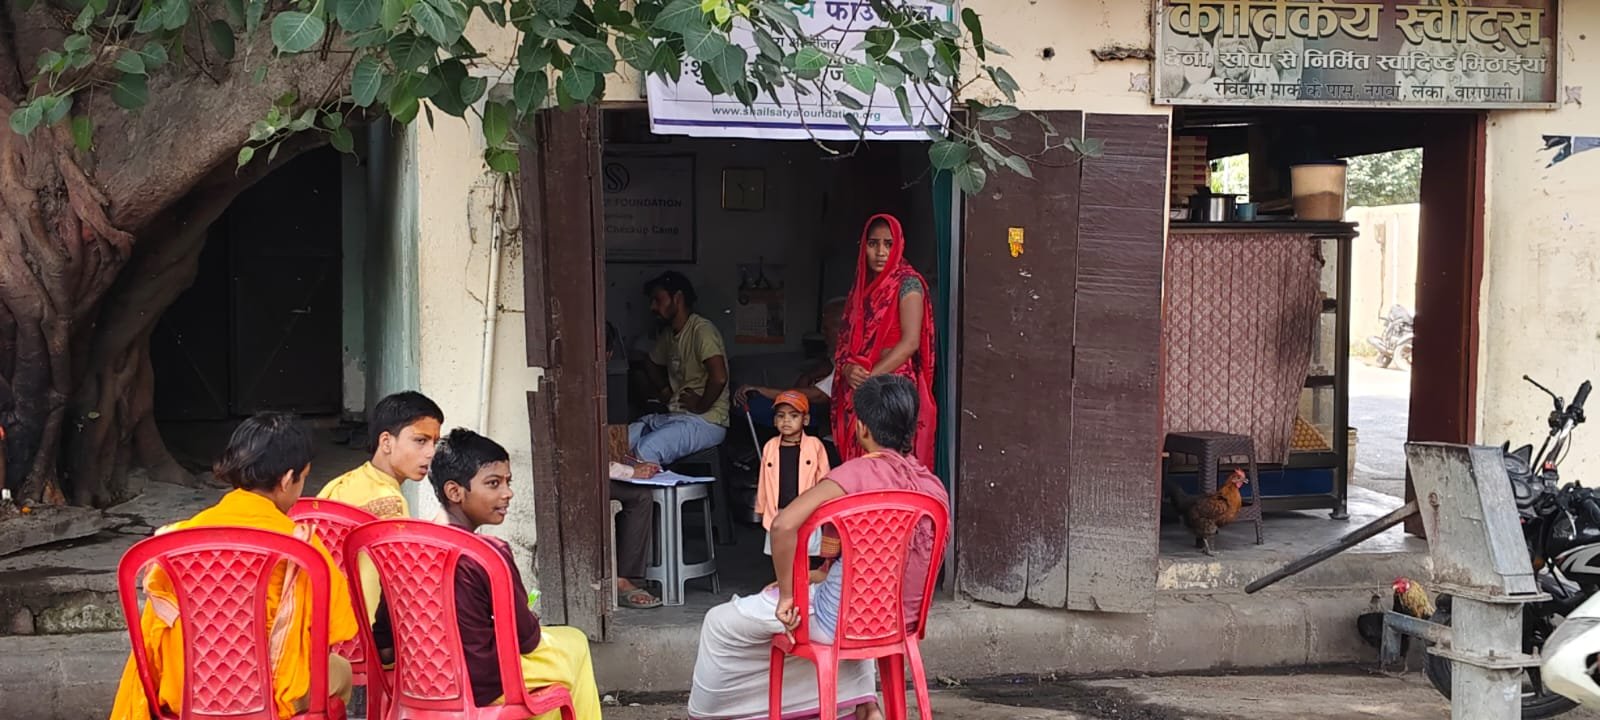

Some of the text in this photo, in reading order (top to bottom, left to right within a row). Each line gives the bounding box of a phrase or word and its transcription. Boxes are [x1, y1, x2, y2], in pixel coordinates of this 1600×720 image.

[1169, 0, 1383, 40] कातिकय
[1278, 49, 1299, 69] से
[1304, 48, 1371, 70] निर्मित
[1376, 52, 1455, 73] स्वादिष्ट
[1213, 78, 1267, 97] रविदास
[1305, 79, 1323, 97] के
[712, 106, 881, 121] www.shailsatyaoundatin.org
[615, 198, 682, 208] FOUNDATION
[651, 224, 680, 237] Camp
